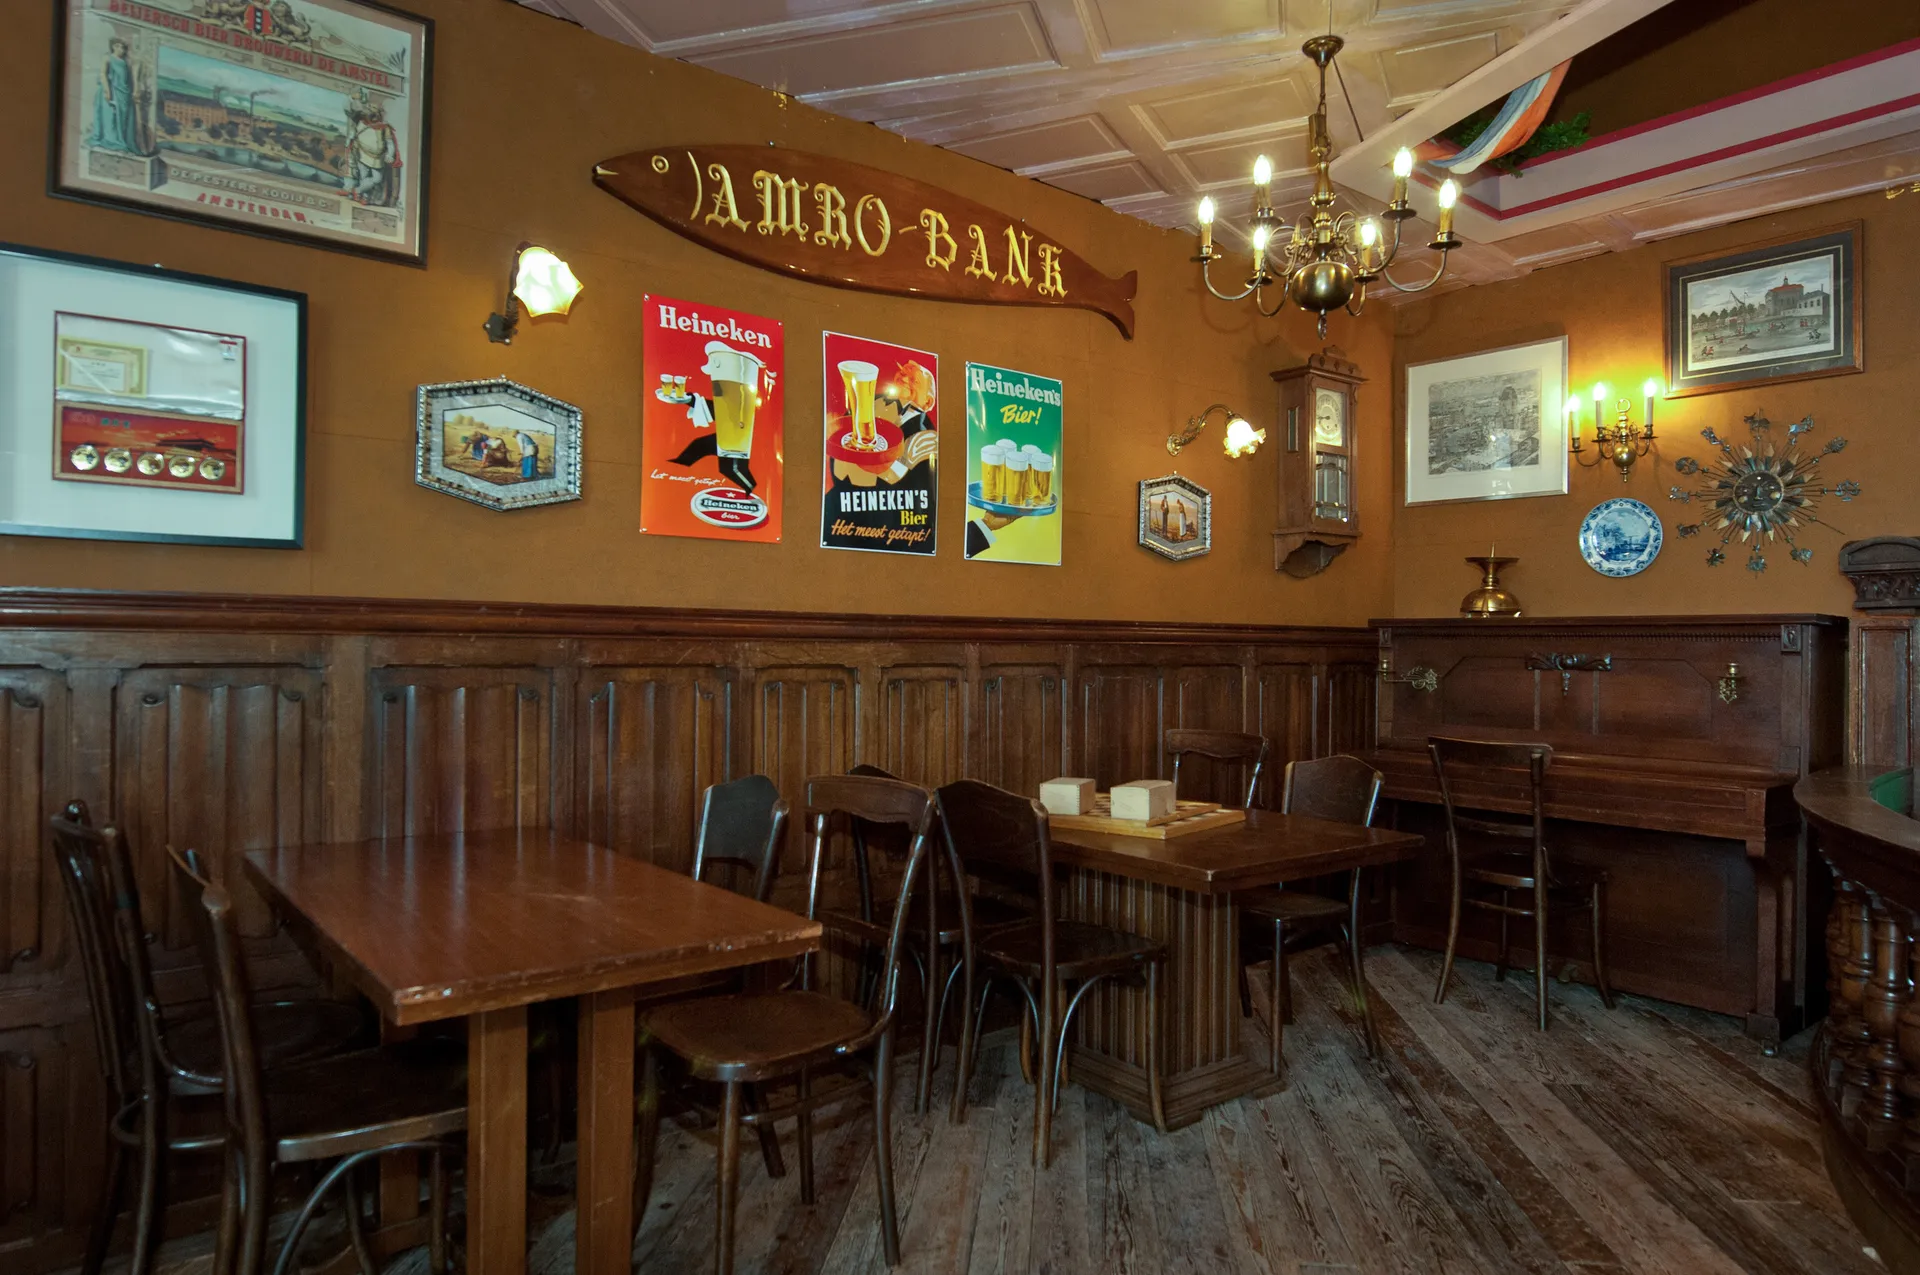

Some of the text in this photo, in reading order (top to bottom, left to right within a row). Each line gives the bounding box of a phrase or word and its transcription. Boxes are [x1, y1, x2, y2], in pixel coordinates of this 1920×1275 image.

[195, 23, 229, 43] BIER
[233, 33, 313, 66] BROUWERIJ
[318, 57, 336, 73] DE
[658, 304, 772, 348] Heineken
[970, 367, 1061, 407] Heineken's
[1000, 403, 1042, 425] Bier!
[703, 499, 758, 511] Heineken
[840, 489, 929, 512] HEINEKEN'S
[900, 510, 928, 526] Bier
[831, 519, 932, 547] Het meest getapt!
